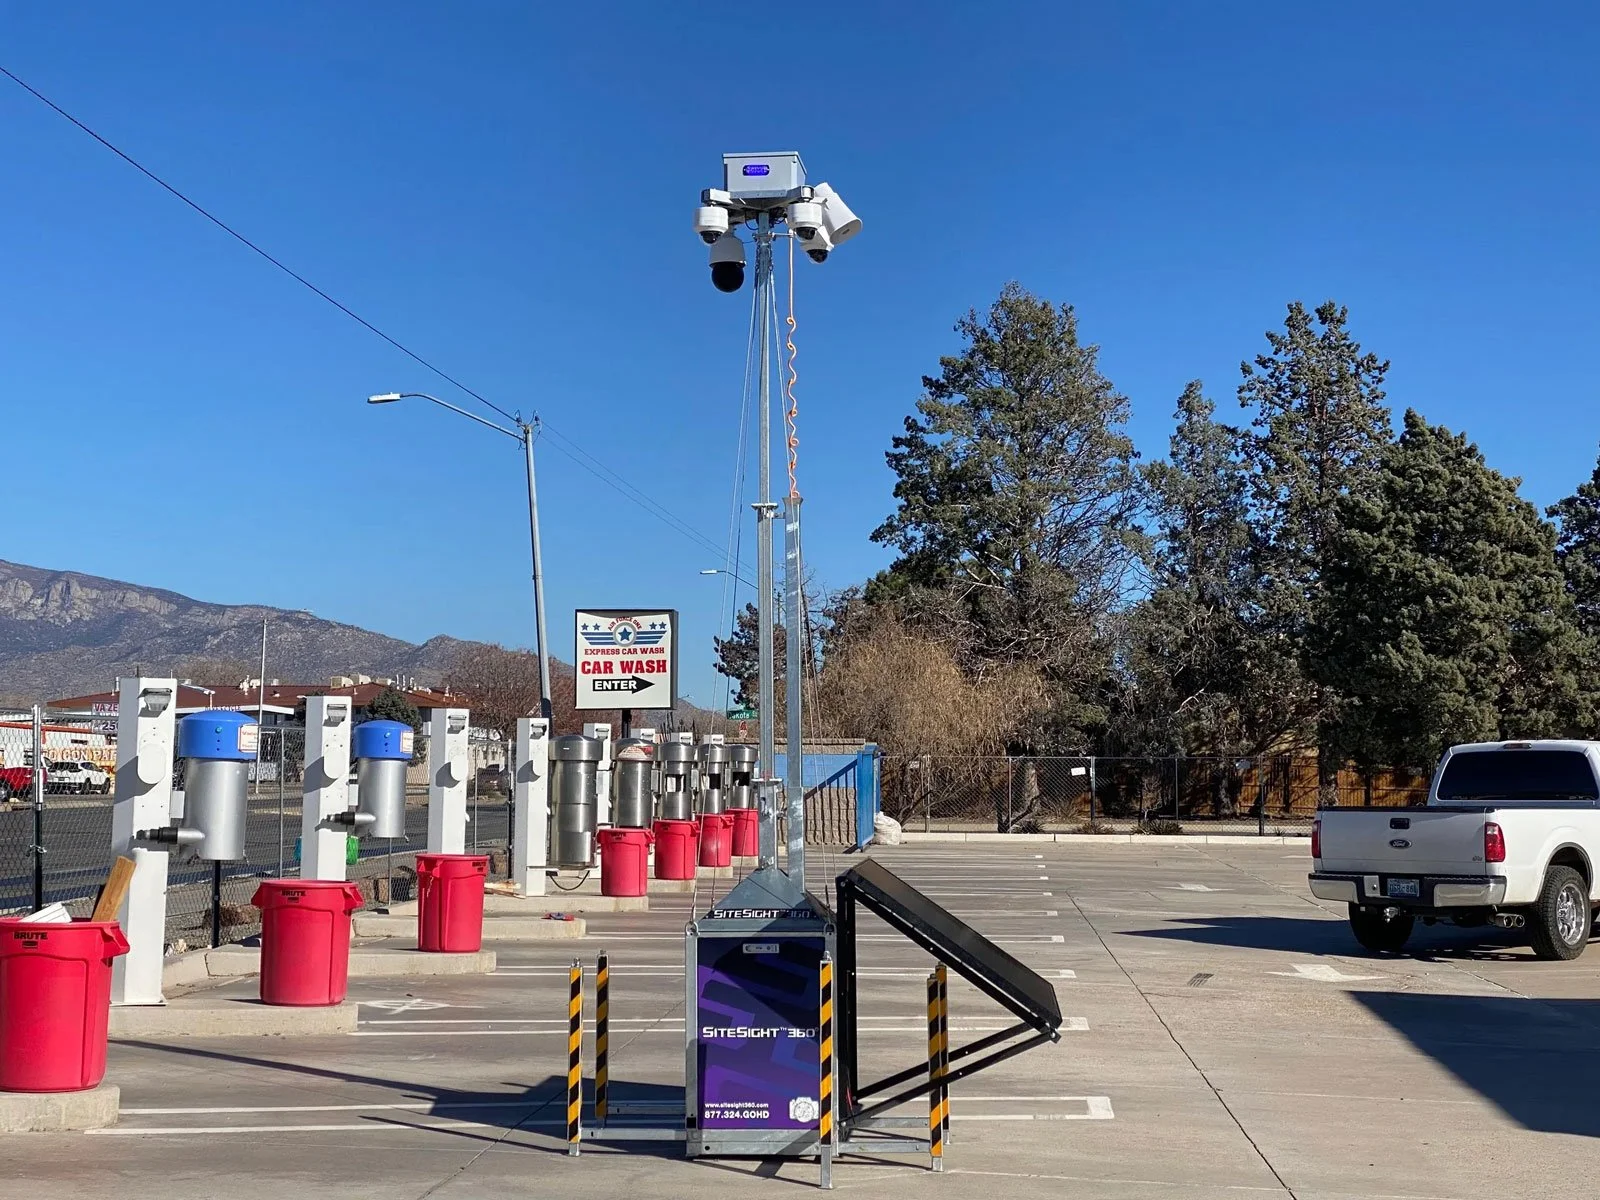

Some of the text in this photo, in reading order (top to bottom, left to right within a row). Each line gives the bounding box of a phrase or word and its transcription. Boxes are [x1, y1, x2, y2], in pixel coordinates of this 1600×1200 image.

[607, 620, 616, 631] AIR
[581, 659, 667, 674] CAR WASH
[594, 680, 637, 690] ENTER
[14, 931, 49, 940] BRUTE
[704, 1110, 770, 1119] 877.324.GOHD
